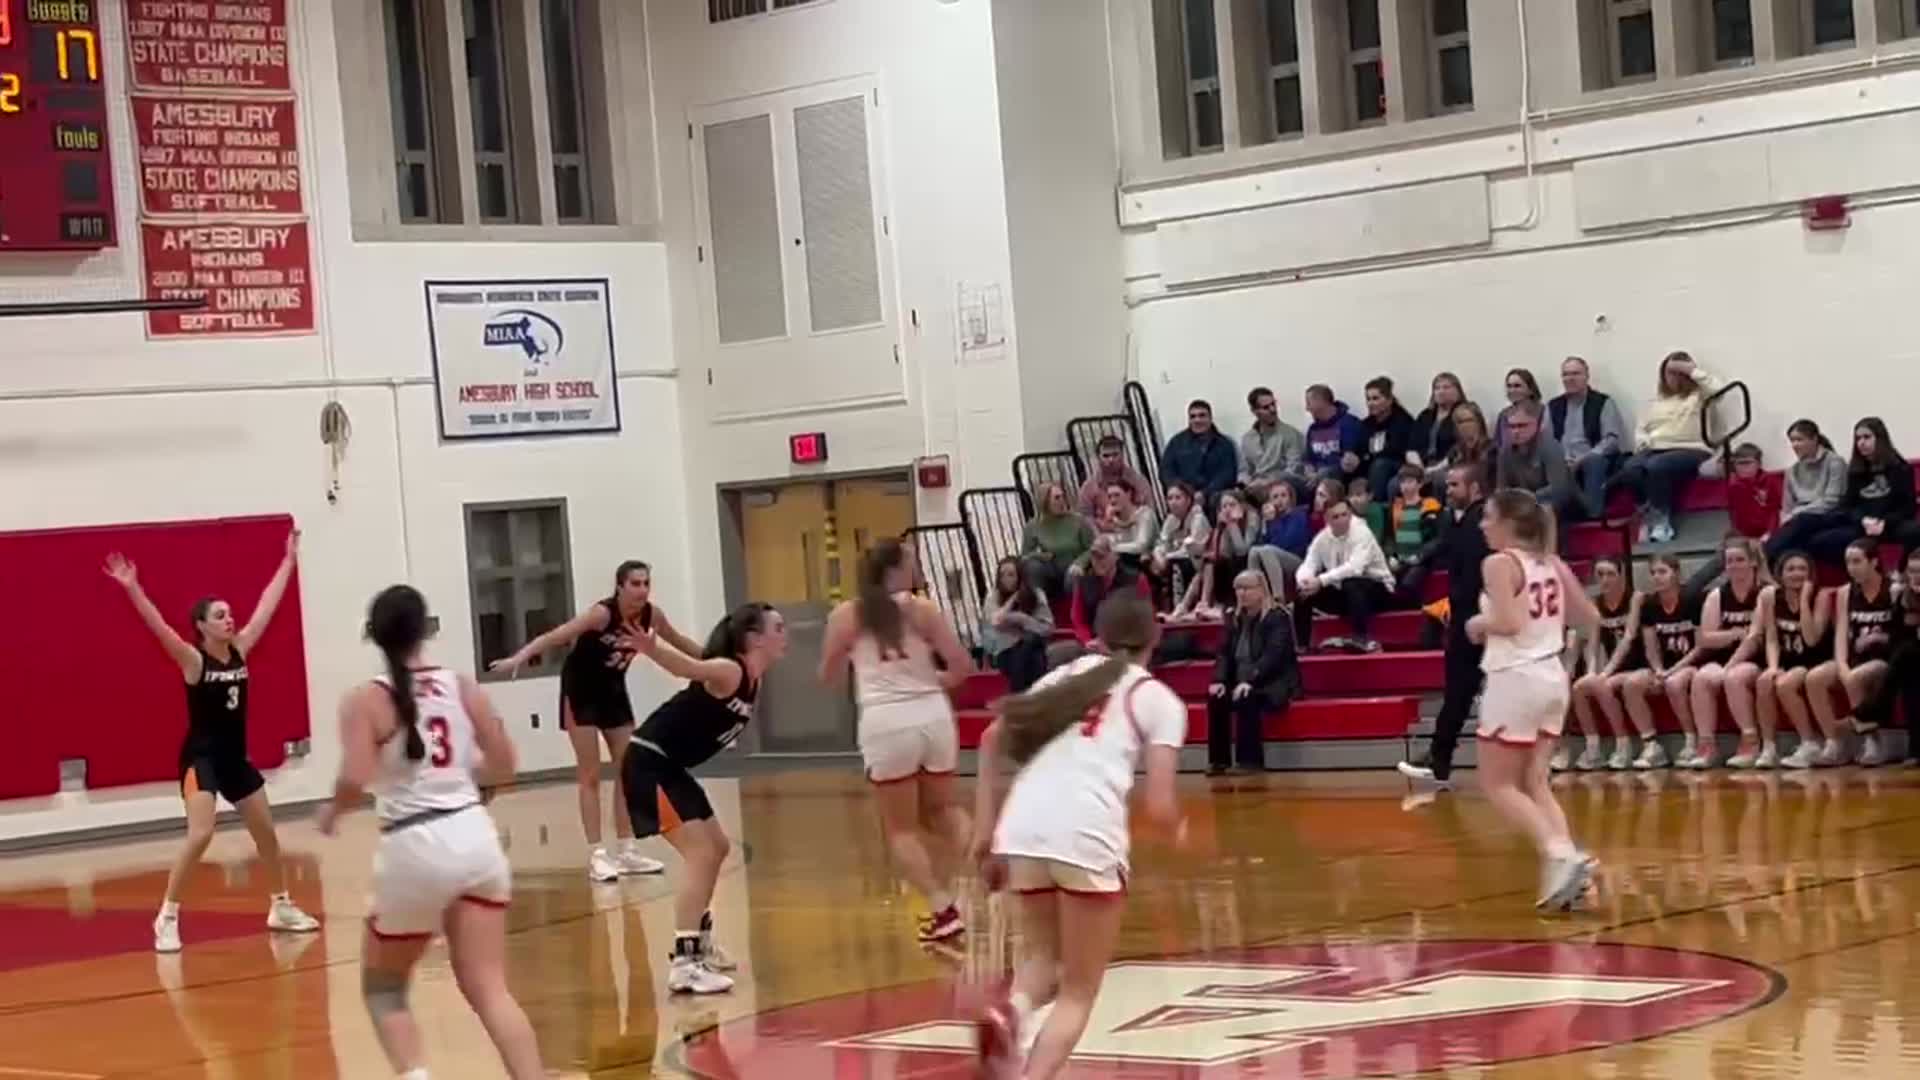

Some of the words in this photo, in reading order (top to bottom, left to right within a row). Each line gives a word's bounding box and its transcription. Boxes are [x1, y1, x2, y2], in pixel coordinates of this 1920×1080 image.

[142, 3, 209, 20] FIGHTING
[215, 4, 272, 23] INDIANS
[57, 30, 97, 79] 17
[134, 41, 190, 63] STATE
[195, 42, 285, 67] CHAMPIONS
[161, 67, 264, 85] BASEBALL
[152, 103, 277, 128] AMESBURY
[153, 128, 218, 145] FIGHTING
[145, 168, 199, 191] STATE
[204, 168, 298, 191] CHAMPIONS
[171, 194, 278, 210] SOFTBALL
[162, 227, 290, 250] AMESBURY
[191, 252, 264, 267] INDIANS
[216, 288, 301, 311] CHAMPIONS
[180, 312, 284, 330] SOFTBALL
[486, 326, 525, 342] MIAA
[459, 384, 517, 404] AMESBURY
[524, 382, 550, 400] HIGH
[556, 381, 599, 399] SCHOOL
[1528, 578, 1559, 619] 32
[226, 685, 240, 710] 3
[426, 716, 453, 769] 3
